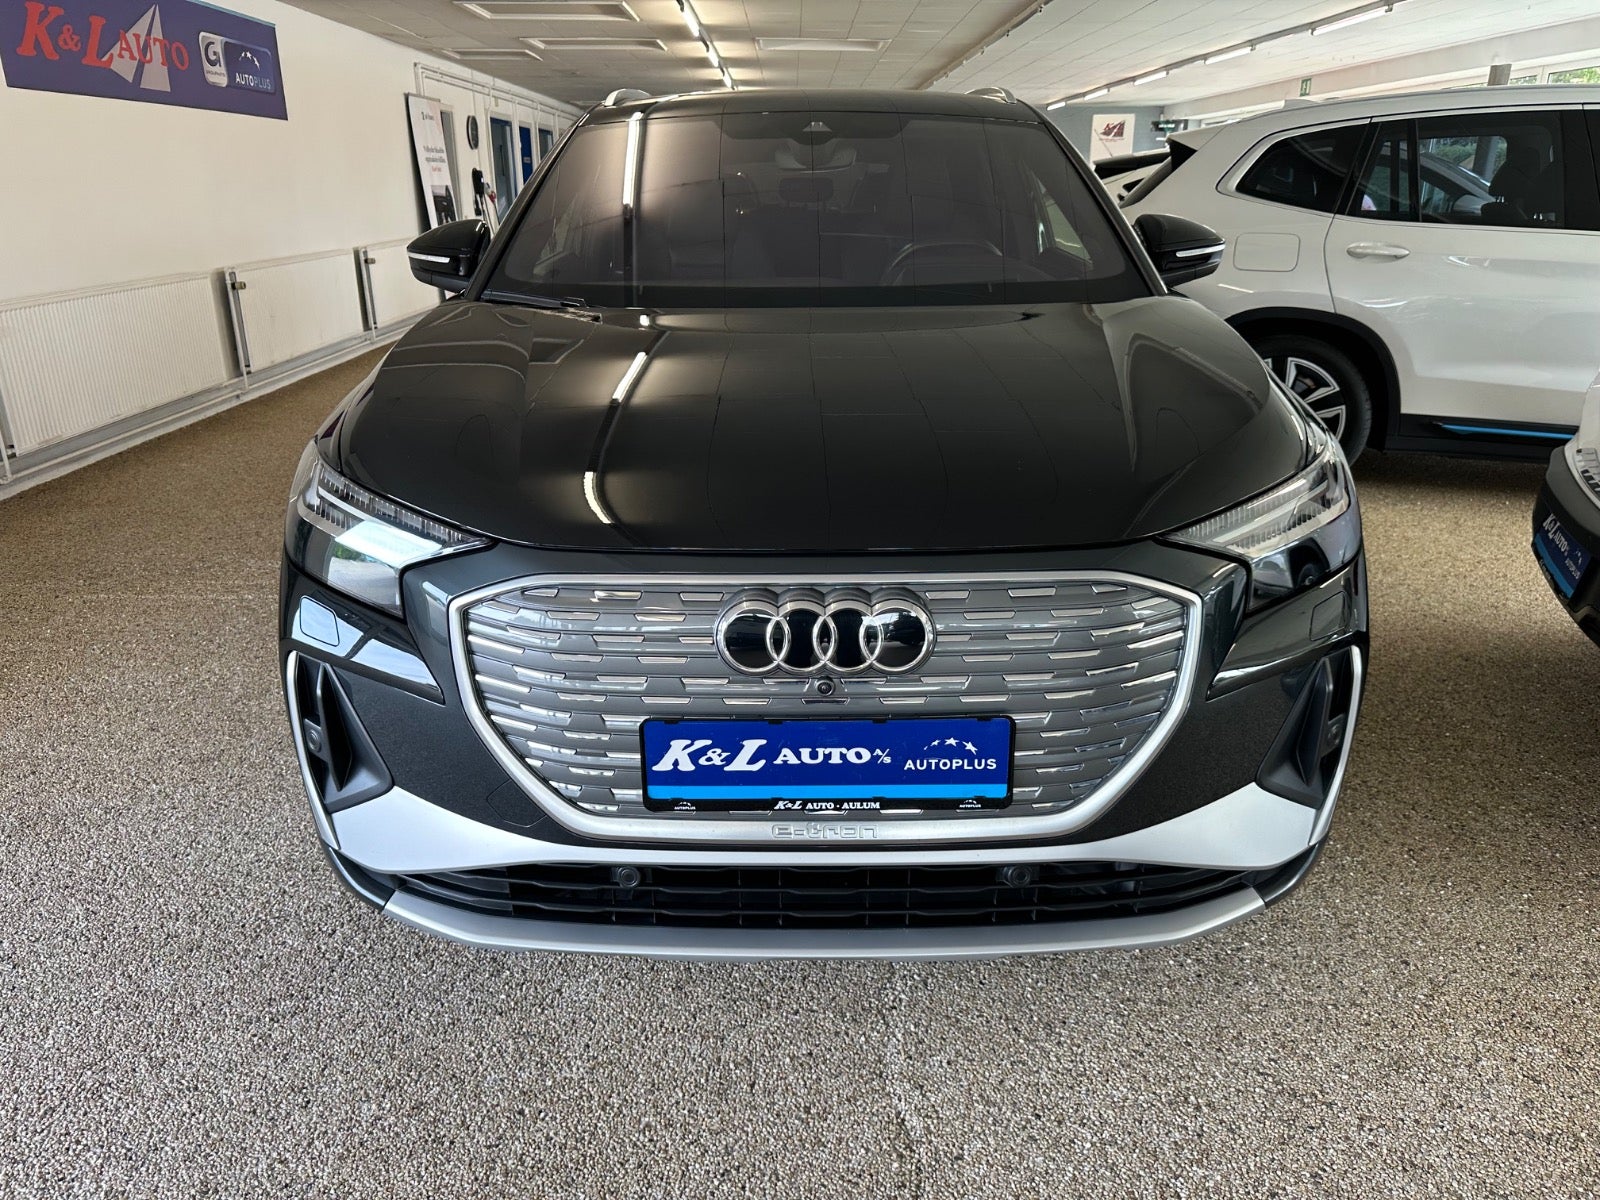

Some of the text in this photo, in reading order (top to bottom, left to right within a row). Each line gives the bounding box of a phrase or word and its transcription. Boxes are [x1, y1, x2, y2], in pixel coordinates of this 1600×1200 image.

[16, 2, 190, 72] K&L AUTO
[235, 72, 272, 91] AUTOPLUS
[1553, 530, 1568, 553] AUTO
[651, 738, 768, 772] K&L
[772, 747, 872, 765] AUTO
[903, 758, 997, 771] AUTOPLUS
[774, 800, 880, 810] K&L AUTO AULUM
[771, 822, 878, 840] e-tron
